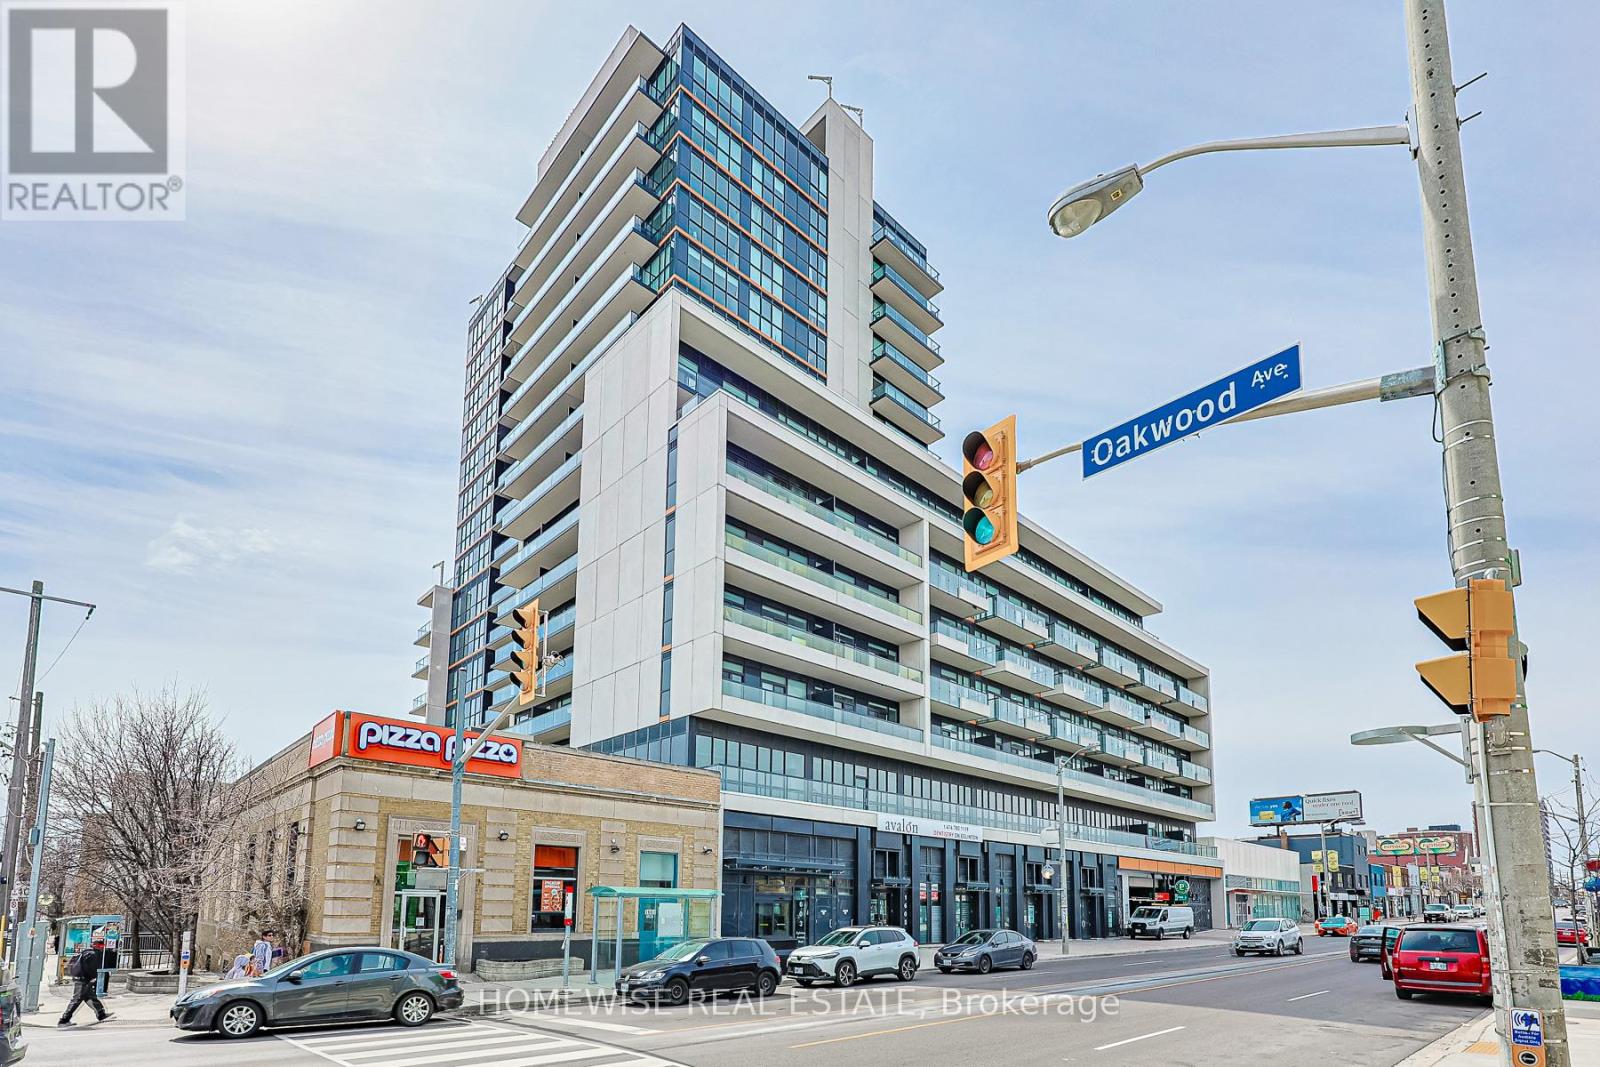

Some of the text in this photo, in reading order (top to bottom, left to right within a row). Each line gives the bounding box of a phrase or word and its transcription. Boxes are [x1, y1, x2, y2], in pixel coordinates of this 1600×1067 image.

[1092, 362, 1287, 465] Oakwood Ave
[358, 721, 441, 754] pizza
